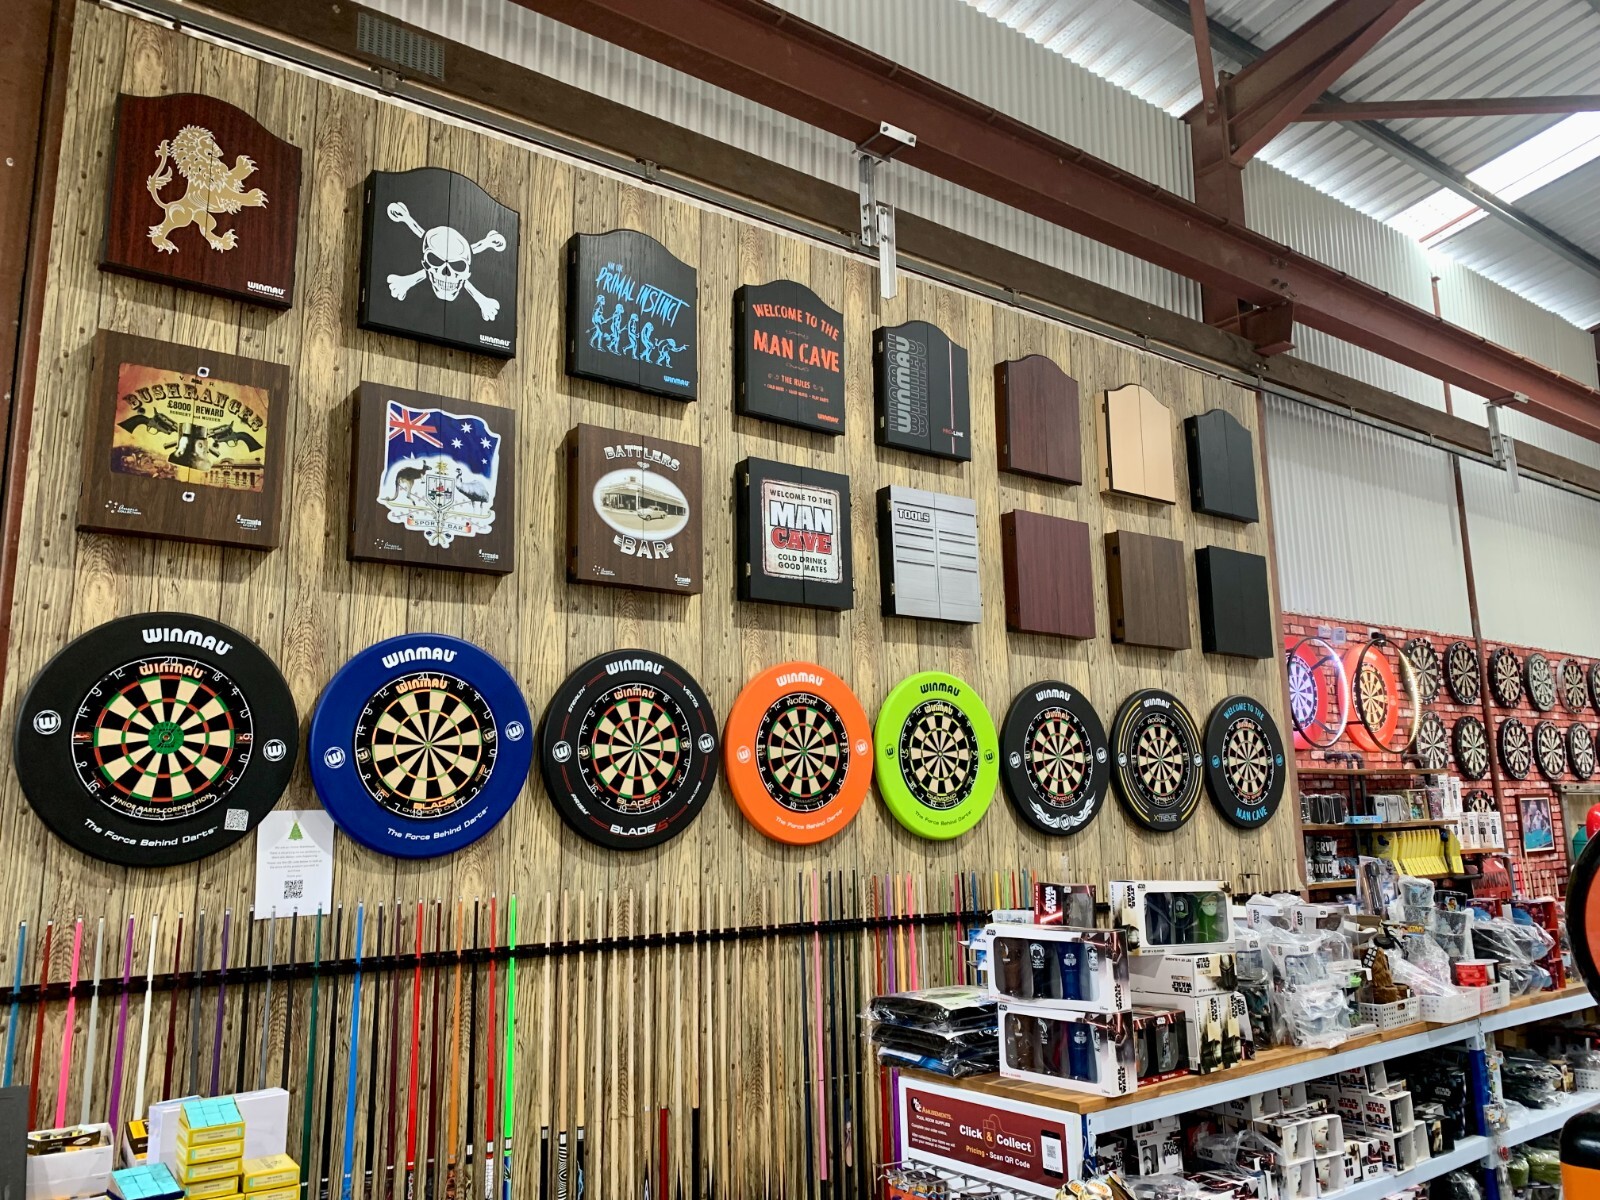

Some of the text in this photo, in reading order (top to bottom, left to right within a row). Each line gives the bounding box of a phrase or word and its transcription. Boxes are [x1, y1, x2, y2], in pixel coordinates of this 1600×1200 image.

[247, 281, 284, 295] WINMAU
[596, 267, 690, 327] PRIMAL INSTINCT
[752, 304, 840, 342] WELCOME TO THE
[480, 335, 510, 346] WINMAU
[754, 330, 840, 373] MAN CAVE
[664, 376, 689, 386] WINMAU
[782, 375, 810, 389] THE RULES
[896, 336, 912, 433] WINMAU
[167, 400, 224, 418] £8000 REWARD
[604, 444, 680, 471] BATTLERS
[770, 489, 805, 501] WELCOME
[819, 497, 832, 506] THE
[769, 500, 833, 535] MAN
[898, 508, 930, 522] TOOLS
[414, 519, 445, 527] SPORTS
[620, 534, 670, 559] BAR
[771, 526, 832, 555] CAVE
[778, 554, 827, 566] COLD DRINKS
[778, 562, 827, 574] GOOD MATES
[142, 628, 230, 656] WINMAU
[382, 647, 456, 669] WINMAU
[112, 669, 125, 679] 12
[605, 659, 664, 675] WINMAU
[212, 670, 223, 682] 18
[776, 672, 823, 687] WINMAU
[231, 687, 239, 696] 4
[920, 682, 960, 696] WINMAU
[1036, 689, 1071, 702] WINMAU
[1144, 698, 1170, 709] WINMAU
[78, 706, 90, 718] 14
[1224, 703, 1265, 721] WELCOME TO THE
[164, 792, 213, 813] CORPORATION
[1236, 806, 1268, 821] MAN CAVE
[776, 816, 786, 825] The
[806, 820, 826, 829] Behind
[84, 818, 101, 833] The
[104, 830, 137, 845] Force
[140, 838, 178, 847] Behind
[387, 828, 402, 837] The
[433, 825, 462, 839] Behind
[960, 1125, 983, 1140] Click
[986, 1132, 992, 1142] &
[996, 1134, 1032, 1152] Collect
[966, 1145, 985, 1158] Pricing
[989, 1152, 1004, 1161] Scan
[1015, 1158, 1030, 1169] Code
